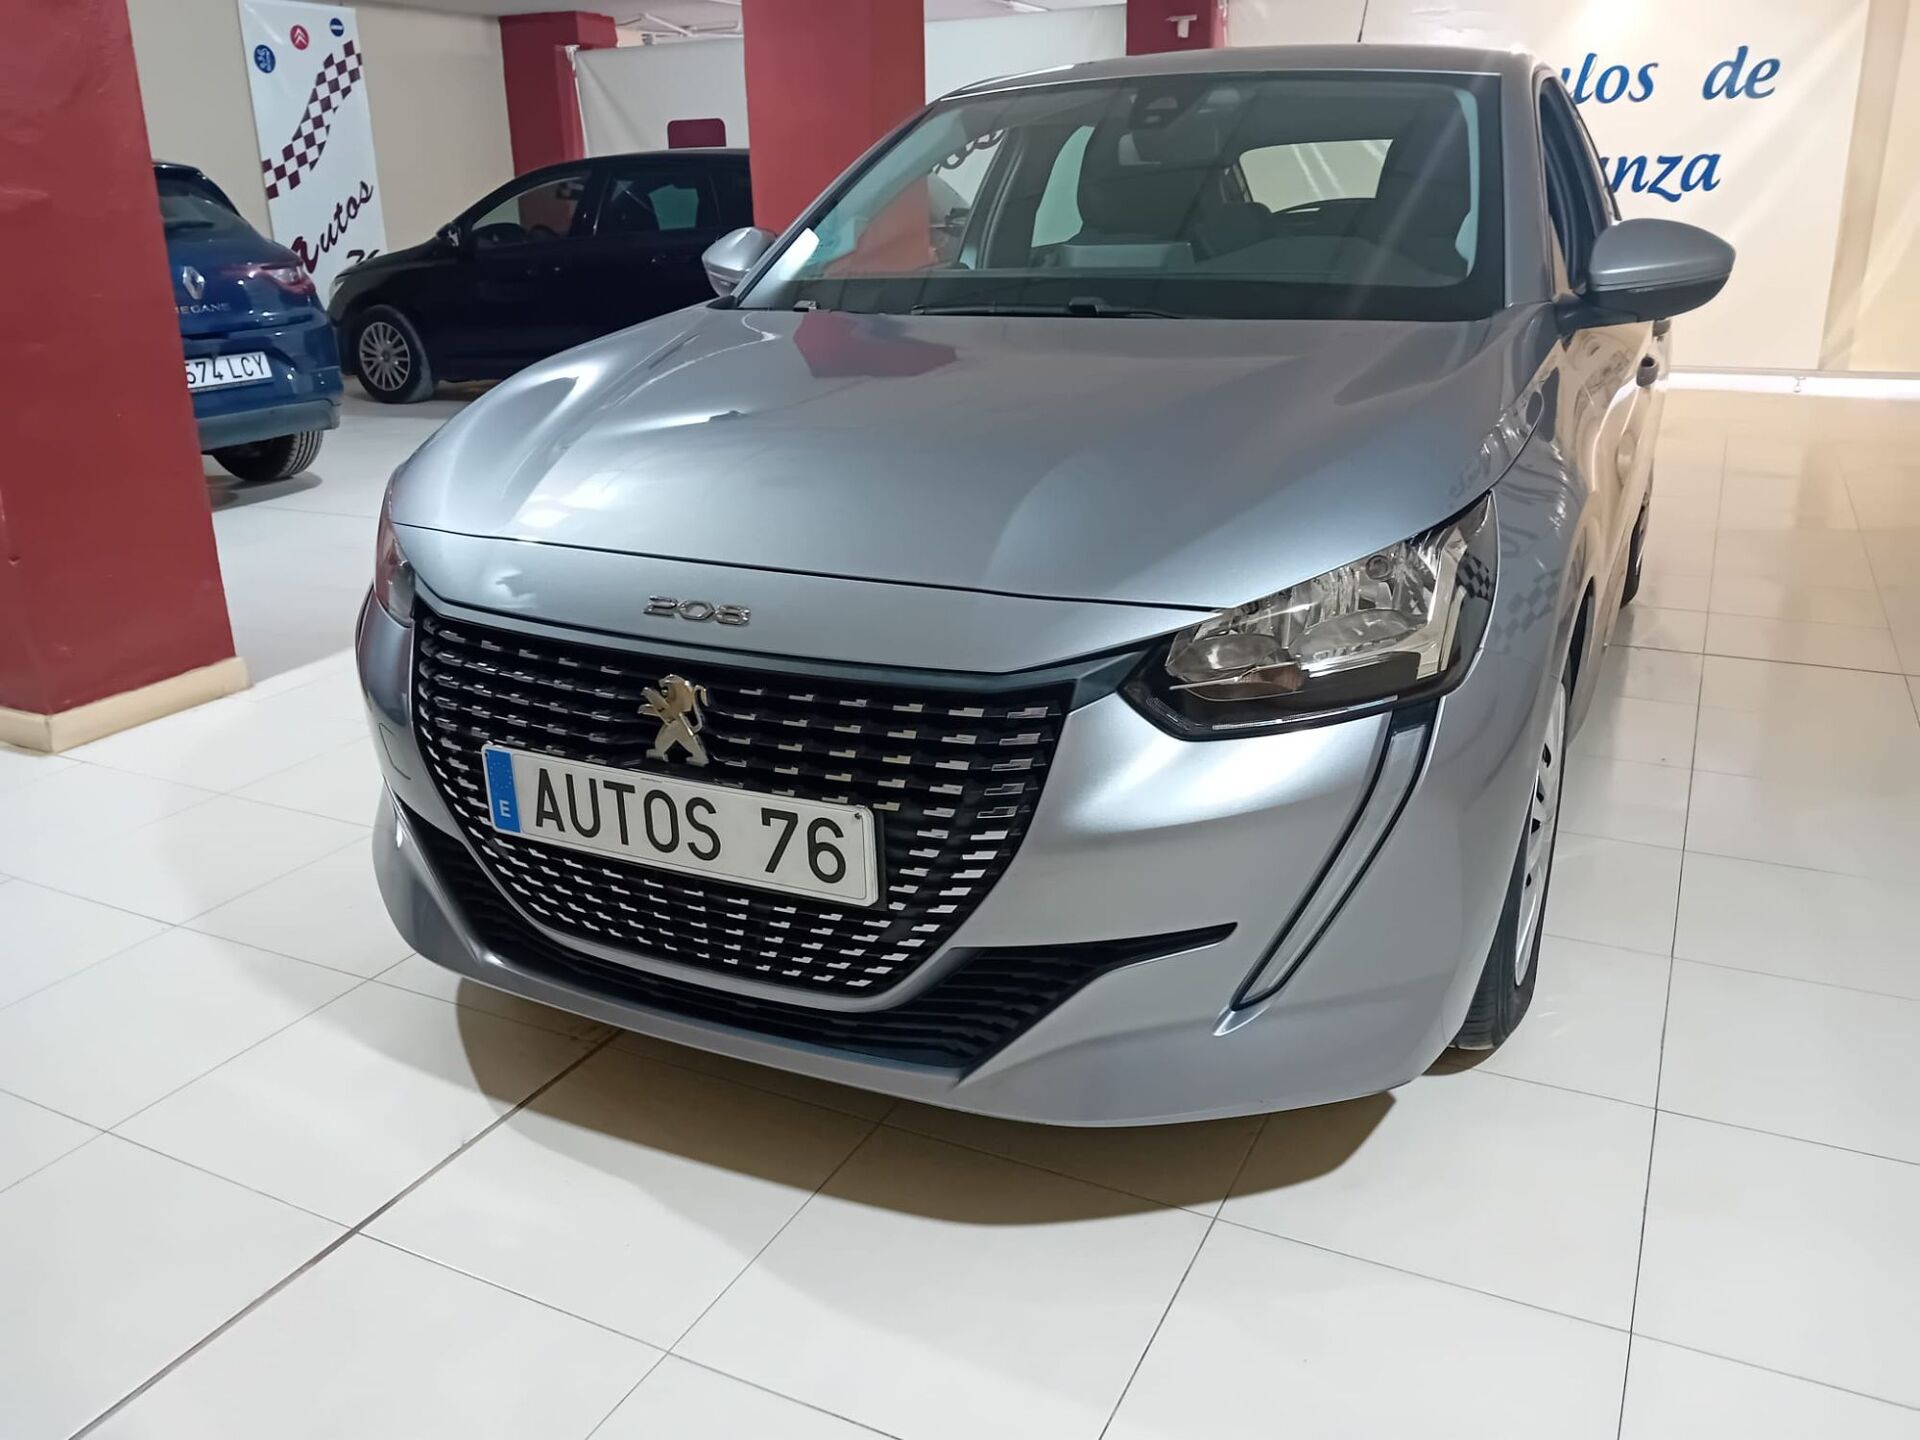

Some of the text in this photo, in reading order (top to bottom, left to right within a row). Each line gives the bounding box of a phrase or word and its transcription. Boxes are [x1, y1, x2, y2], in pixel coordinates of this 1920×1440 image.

[1702, 45, 1781, 100] de
[1599, 153, 1721, 203] nza
[226, 355, 264, 379] LCY
[643, 595, 751, 626] 208
[498, 800, 512, 818] E
[535, 768, 847, 884] AUTOS 76
